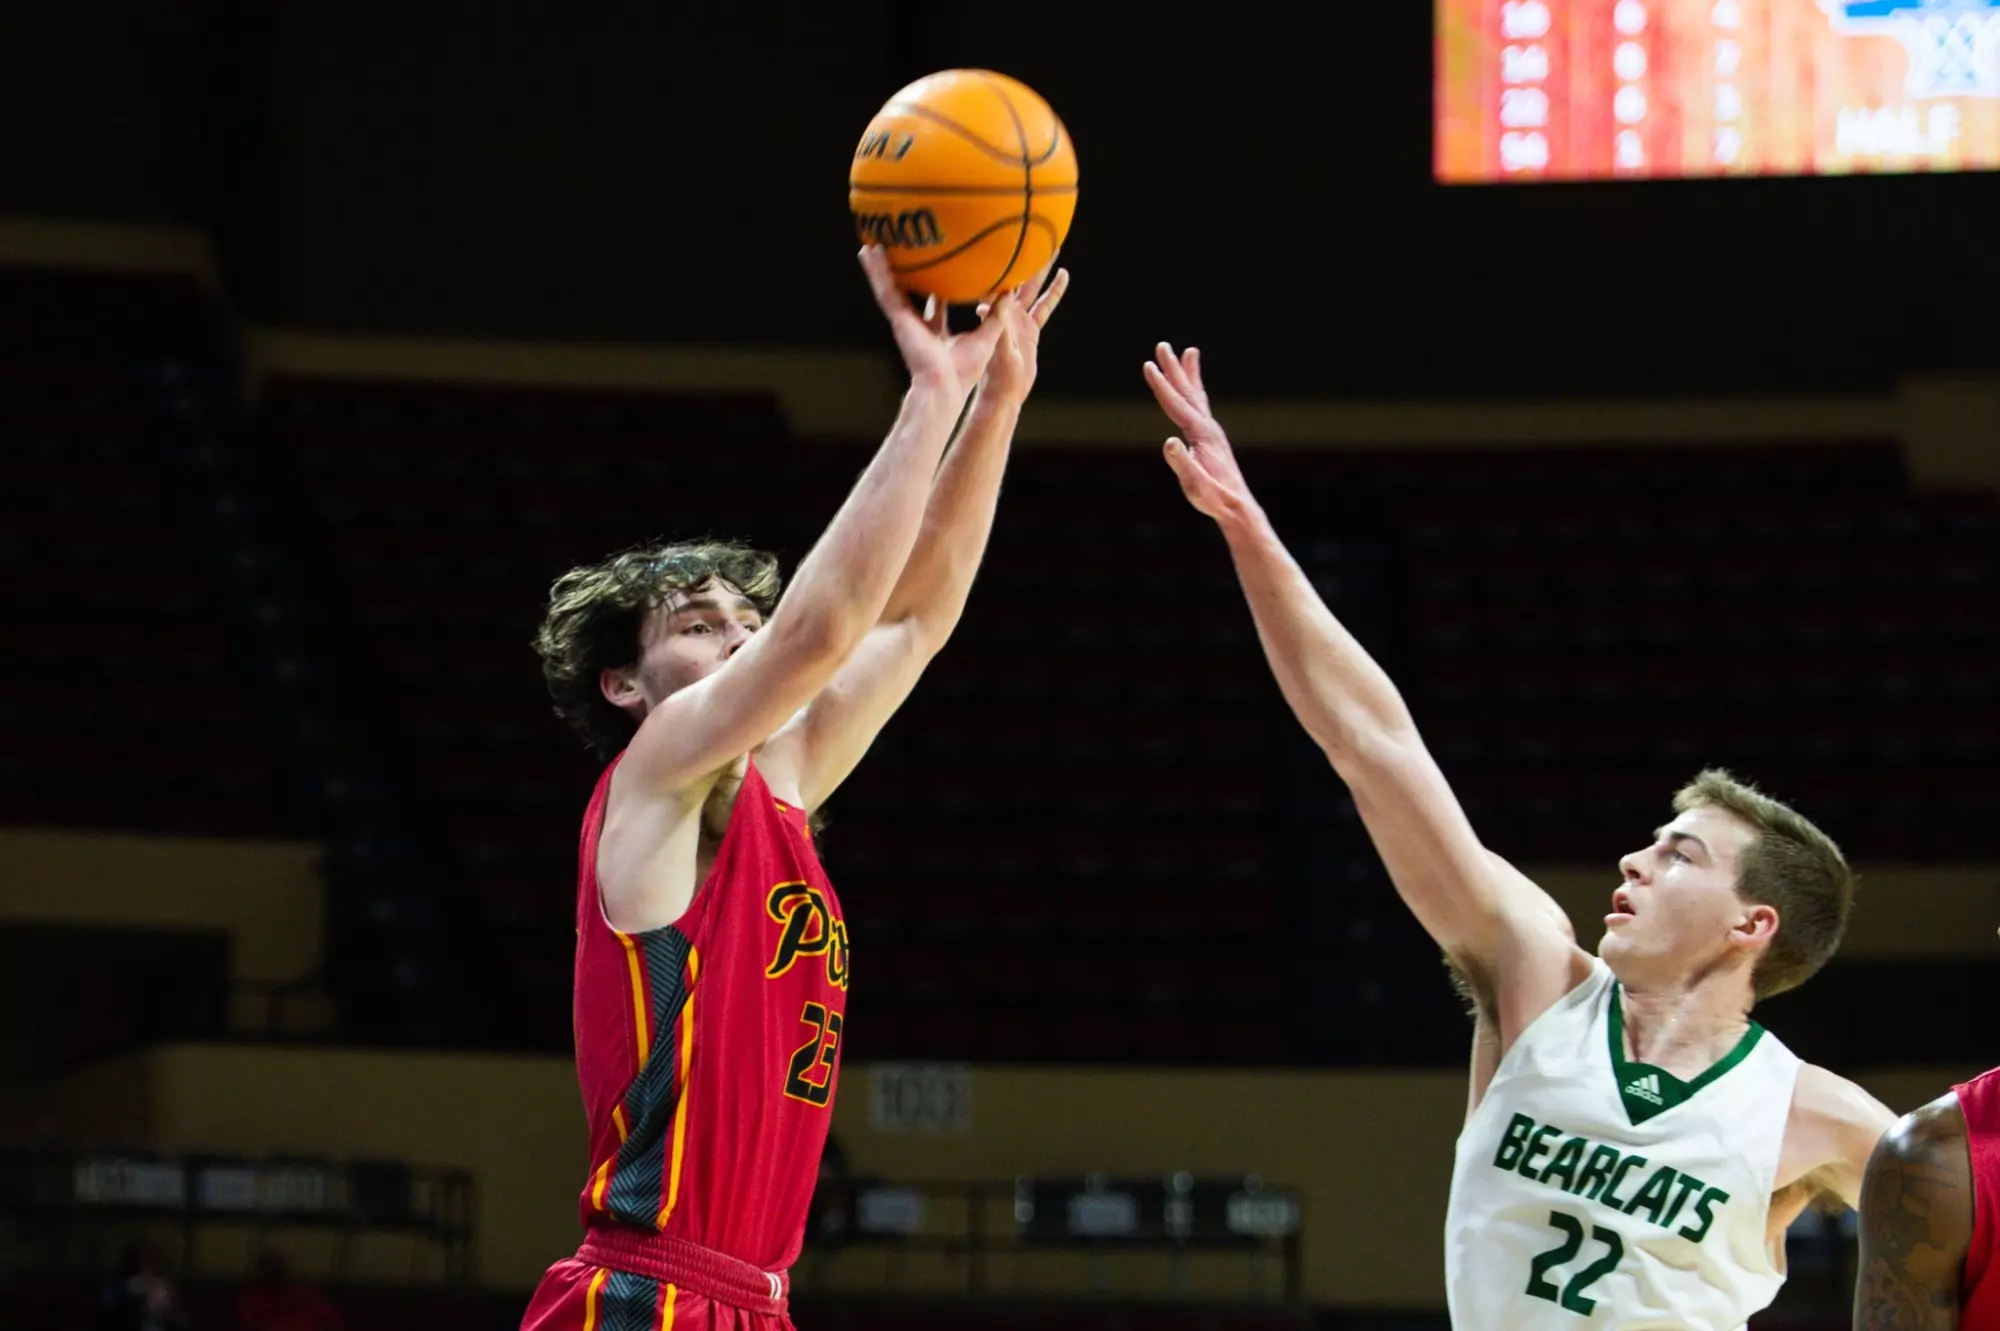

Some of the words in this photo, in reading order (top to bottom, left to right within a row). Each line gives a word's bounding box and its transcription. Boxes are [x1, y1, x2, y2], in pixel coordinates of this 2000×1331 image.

[784, 1001, 844, 1107] 23
[1493, 1112, 1730, 1243] BEARCATS
[1525, 1210, 1624, 1317] 22
